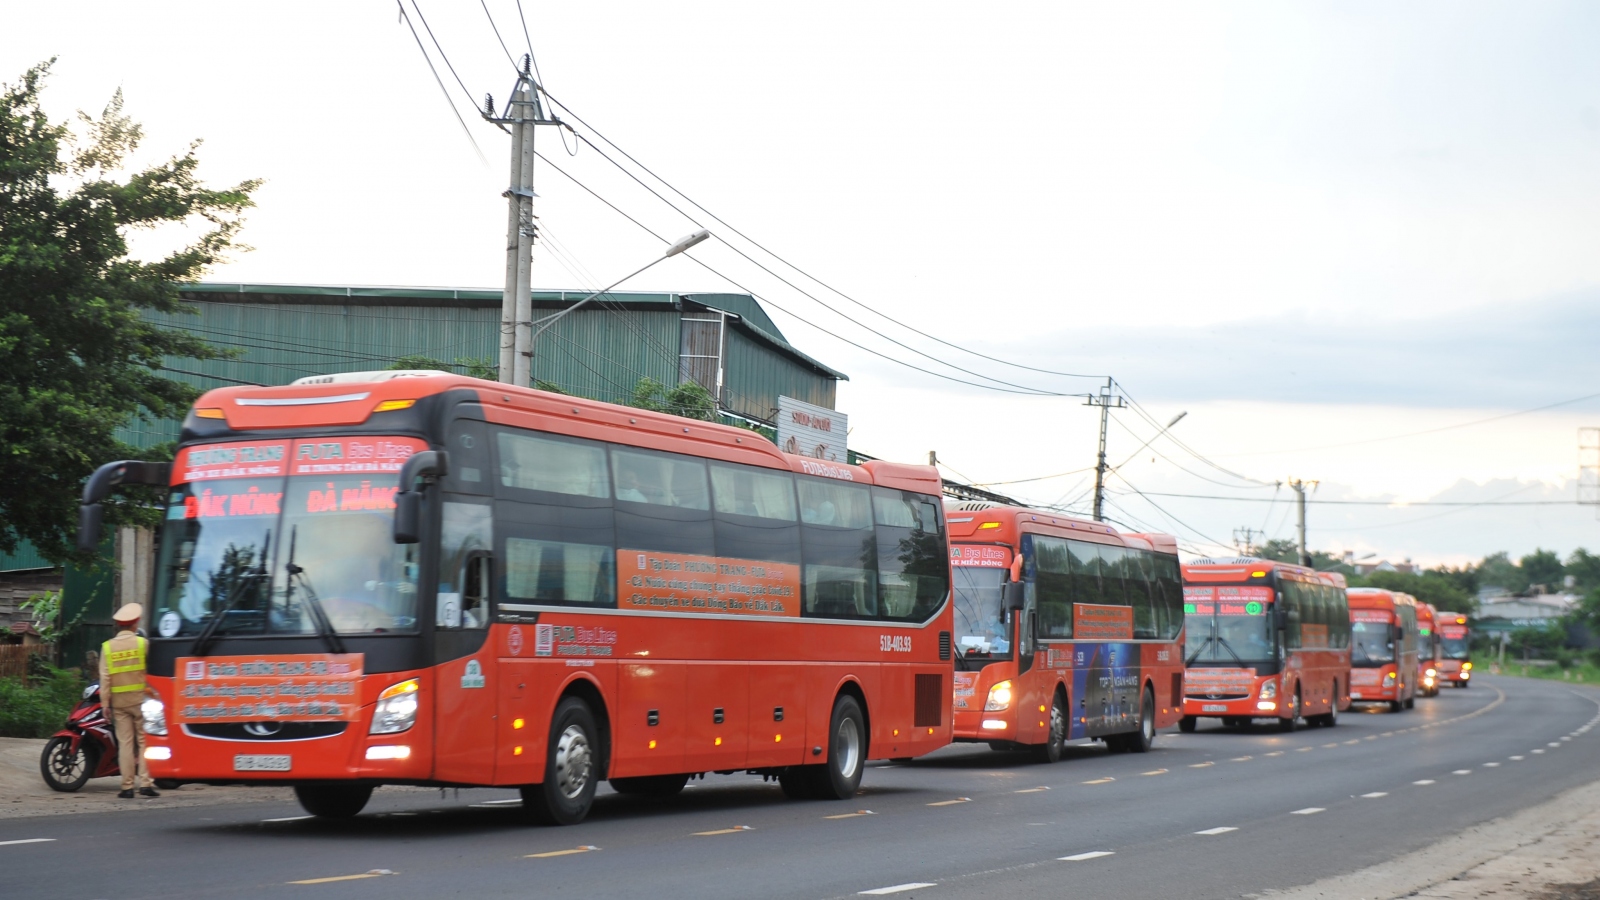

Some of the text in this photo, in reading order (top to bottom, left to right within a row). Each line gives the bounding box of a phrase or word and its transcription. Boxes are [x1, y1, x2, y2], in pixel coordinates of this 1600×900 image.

[296, 441, 414, 461] FUTA Bus Lines
[802, 460, 824, 476] FUTA
[965, 547, 980, 558] Bus
[982, 548, 1005, 559] Lines
[720, 564, 746, 576] TRANG
[553, 626, 577, 643] FUTA
